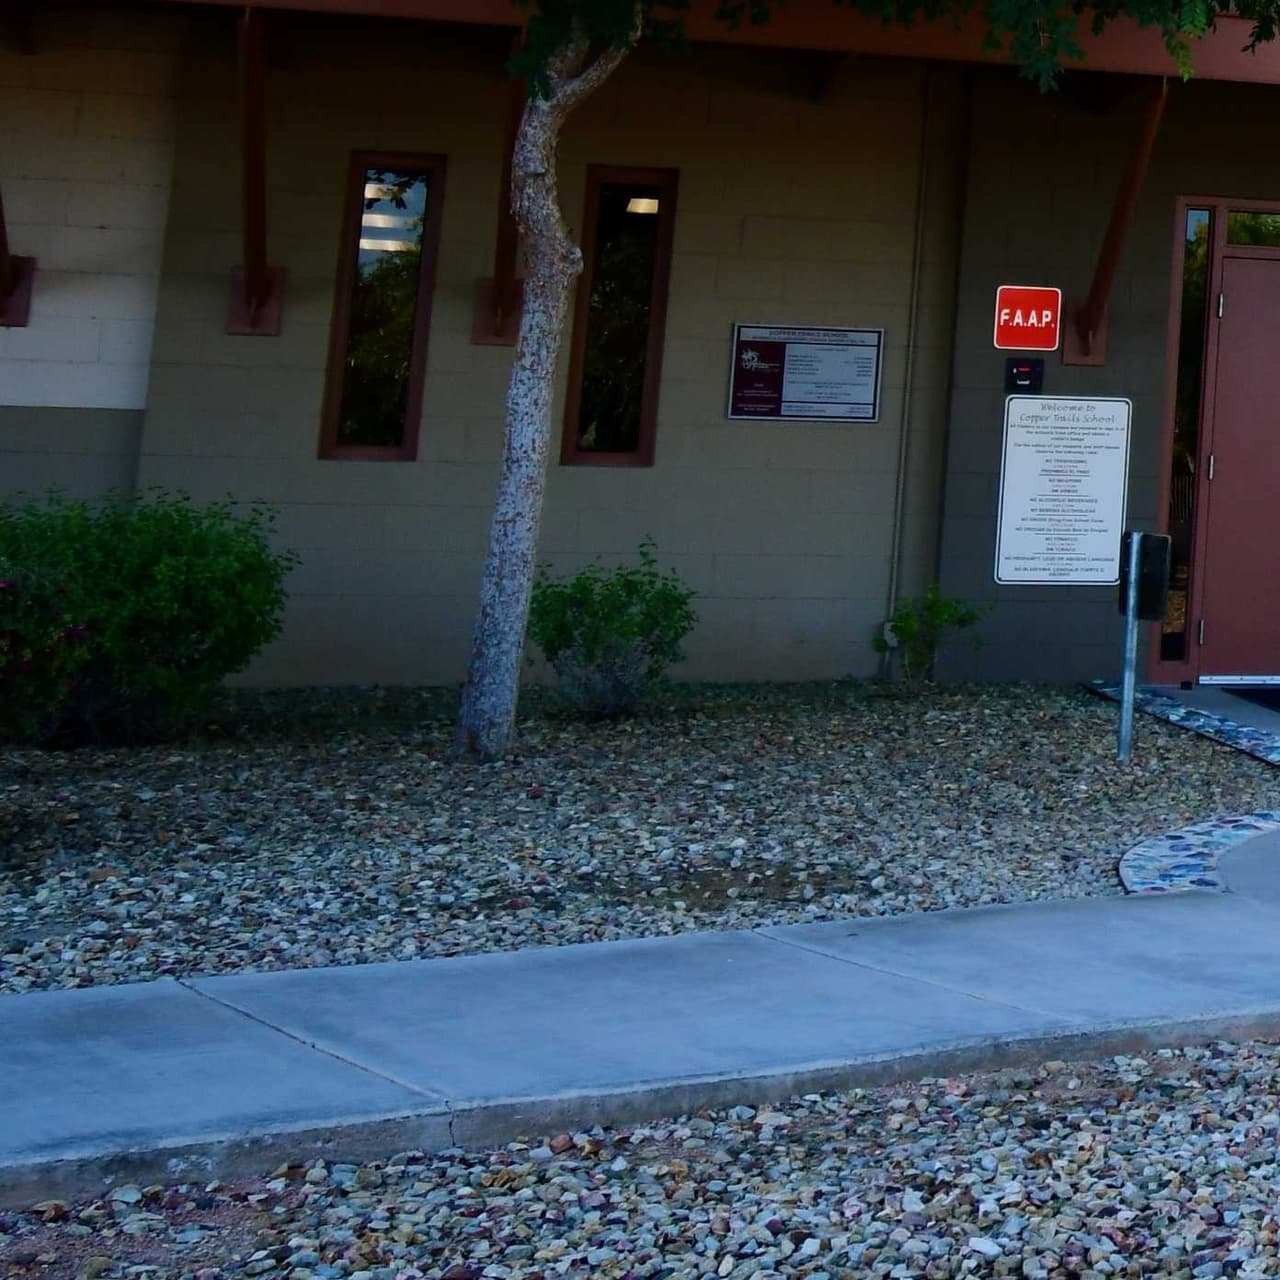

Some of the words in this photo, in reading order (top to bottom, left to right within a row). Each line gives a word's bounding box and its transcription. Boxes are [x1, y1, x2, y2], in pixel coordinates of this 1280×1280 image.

[1000, 308, 1055, 328] F.A.A.P.
[1040, 402, 1083, 412] Welcome
[1086, 403, 1096, 412] to
[1019, 413, 1050, 425] Copper
[1053, 413, 1080, 423] Trails
[1082, 414, 1115, 424] School
